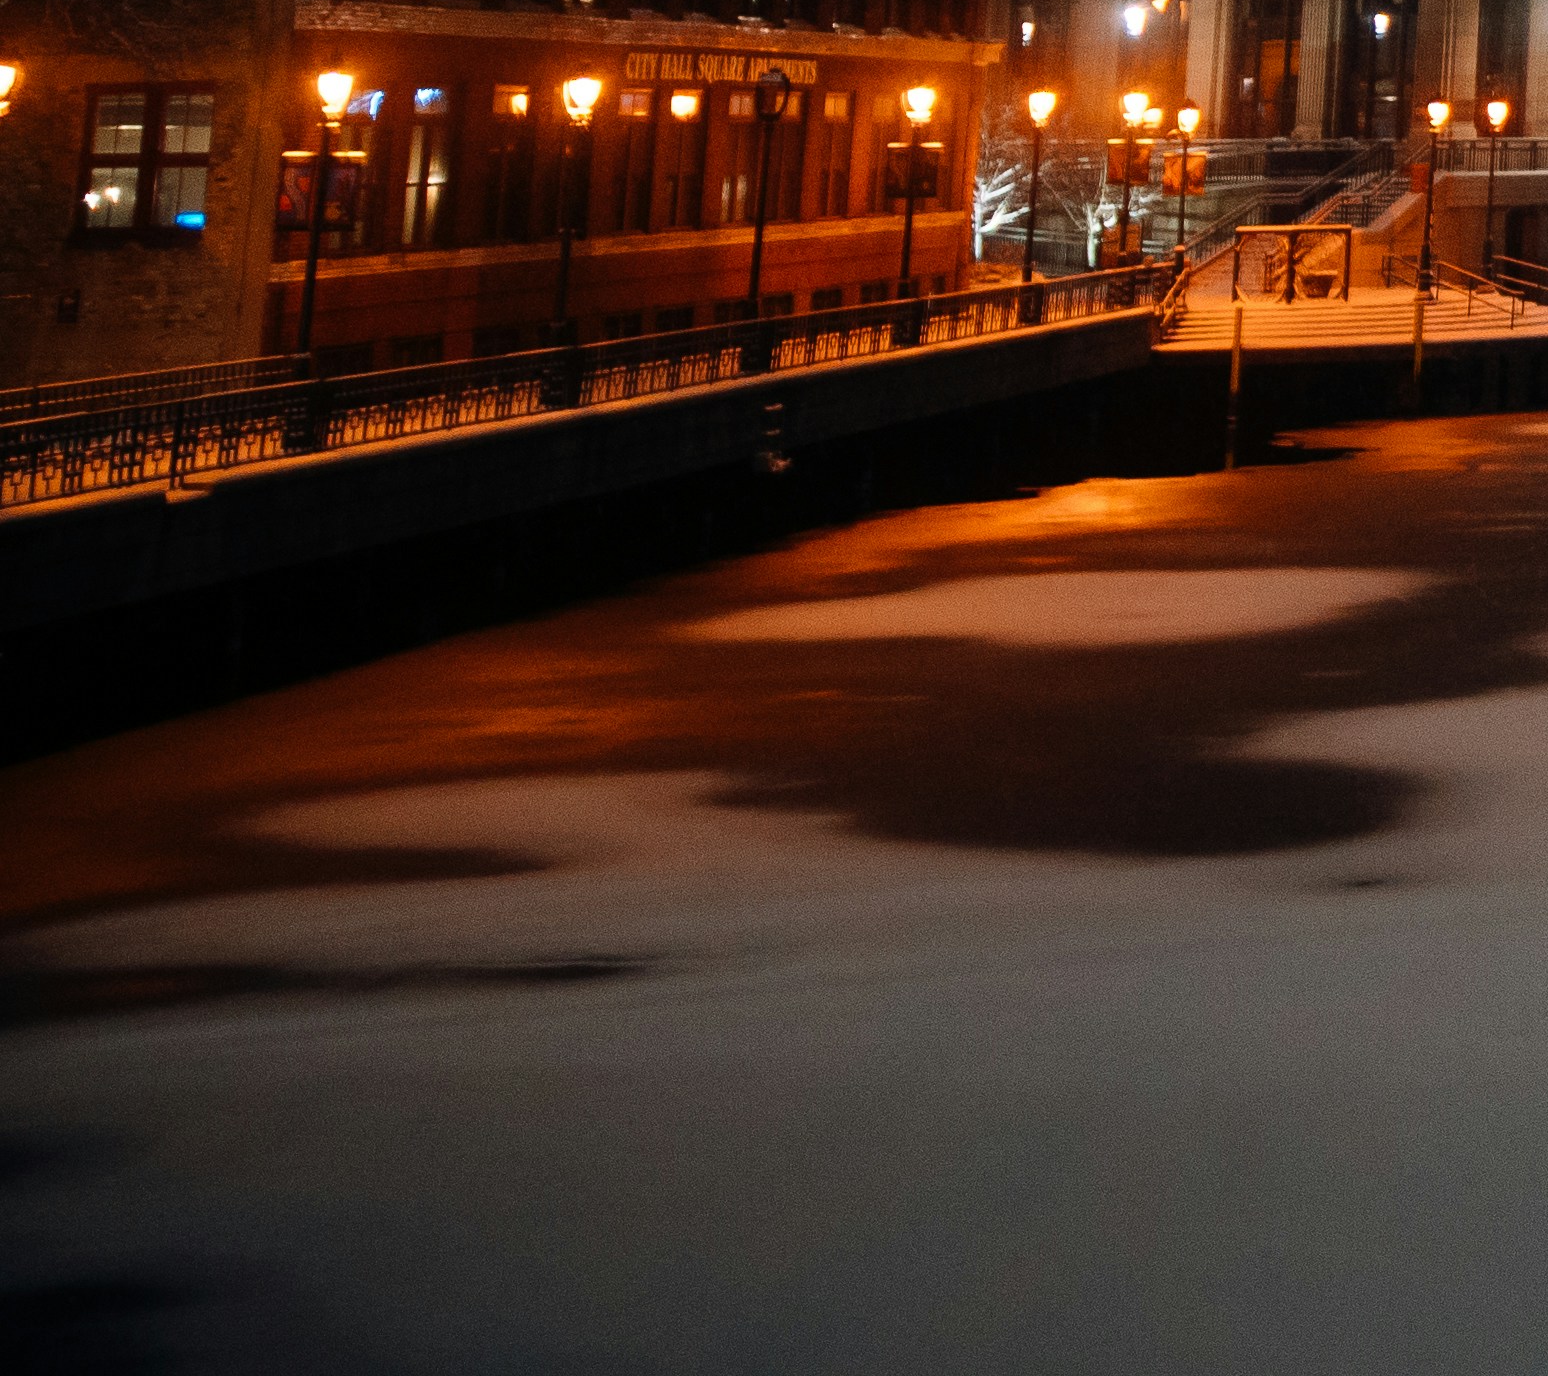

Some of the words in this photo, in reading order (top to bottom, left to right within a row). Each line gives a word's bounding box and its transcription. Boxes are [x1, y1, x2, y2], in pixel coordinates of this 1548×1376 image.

[626, 52, 658, 79] CITY
[660, 53, 693, 80] HALL
[697, 53, 746, 84] SQUARE
